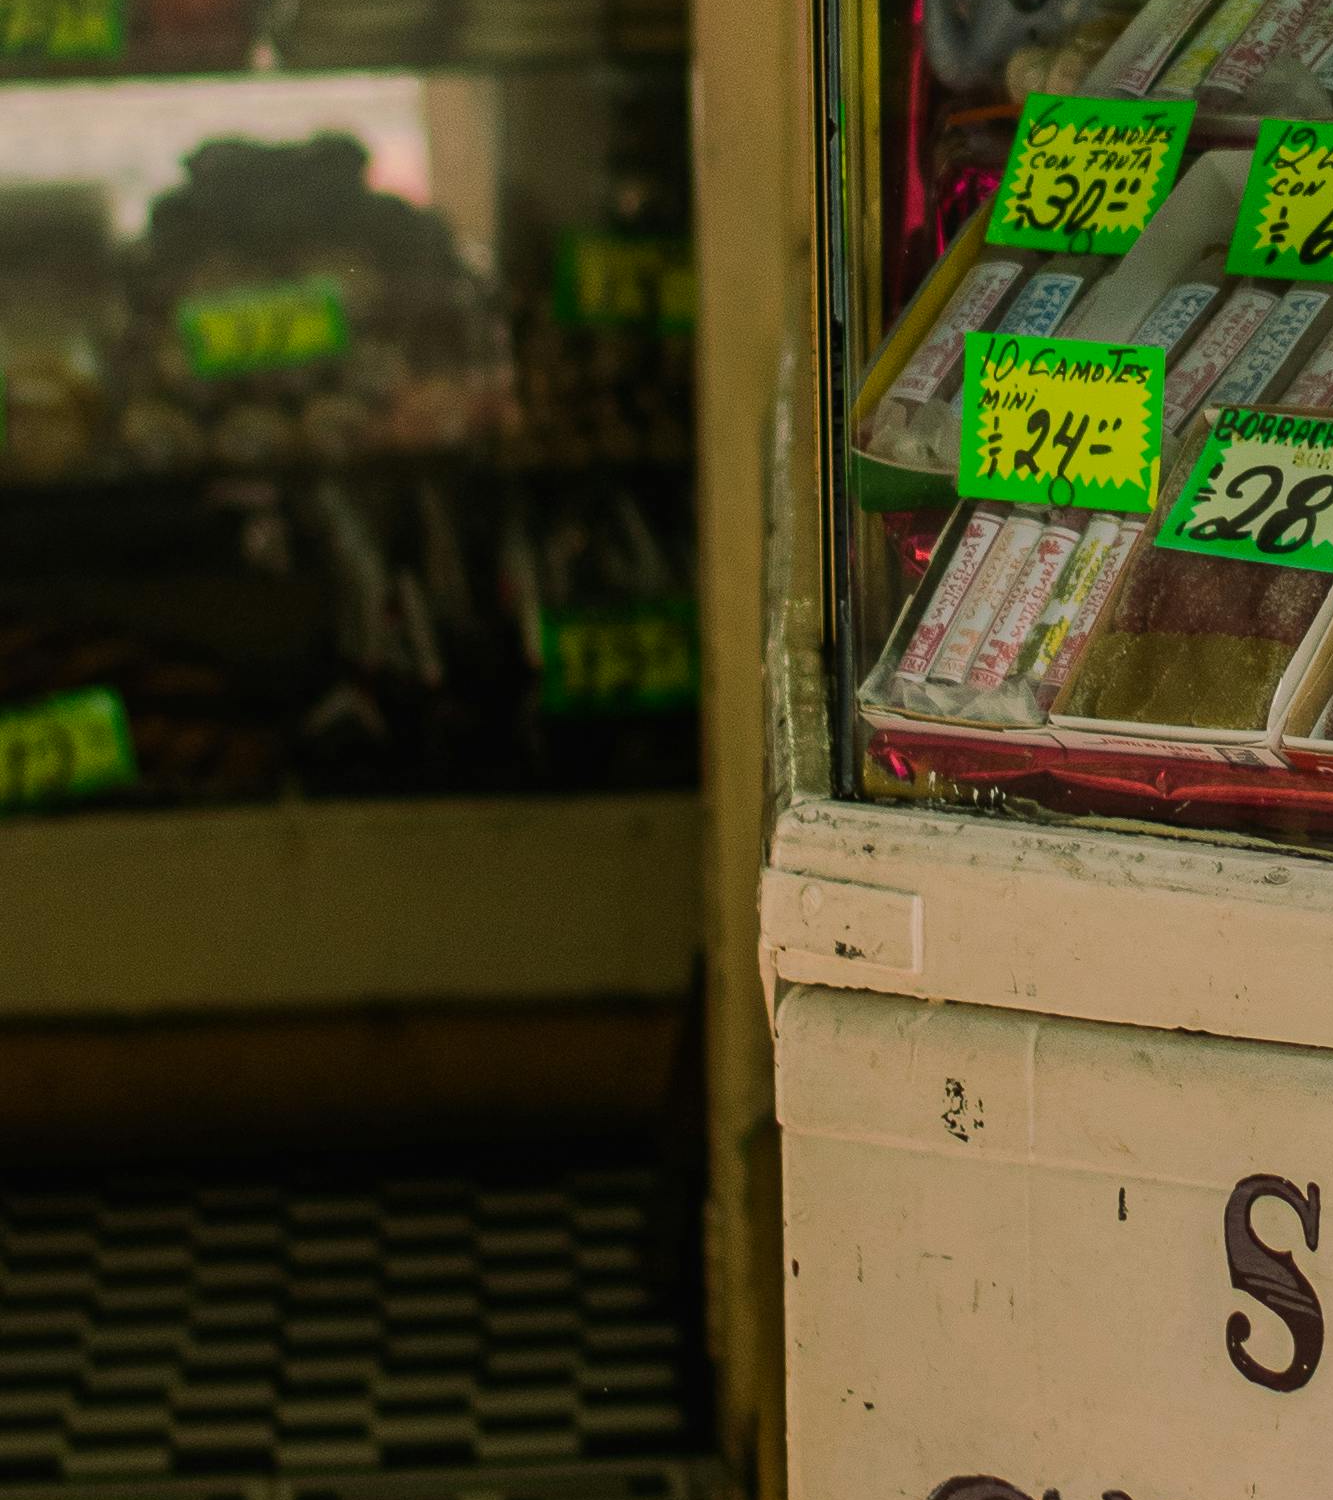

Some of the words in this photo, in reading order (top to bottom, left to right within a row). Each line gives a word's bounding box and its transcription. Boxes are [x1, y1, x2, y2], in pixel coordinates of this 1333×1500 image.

[1029, 101, 1064, 148] 6
[1074, 113, 1176, 145] CAMOTES
[1030, 151, 1075, 170] CON
[1084, 147, 1152, 173] FRUTA
[1263, 125, 1317, 174] 12
[1272, 178, 1326, 197] CON
[1246, 292, 1307, 372] CLARA
[980, 337, 1019, 382] 10
[1028, 348, 1149, 384] CAMOTES
[930, 583, 955, 622] SANTA
[950, 540, 979, 584] CLARA
[1009, 598, 1037, 639] SANTA
[1030, 558, 1059, 600] CLARA
